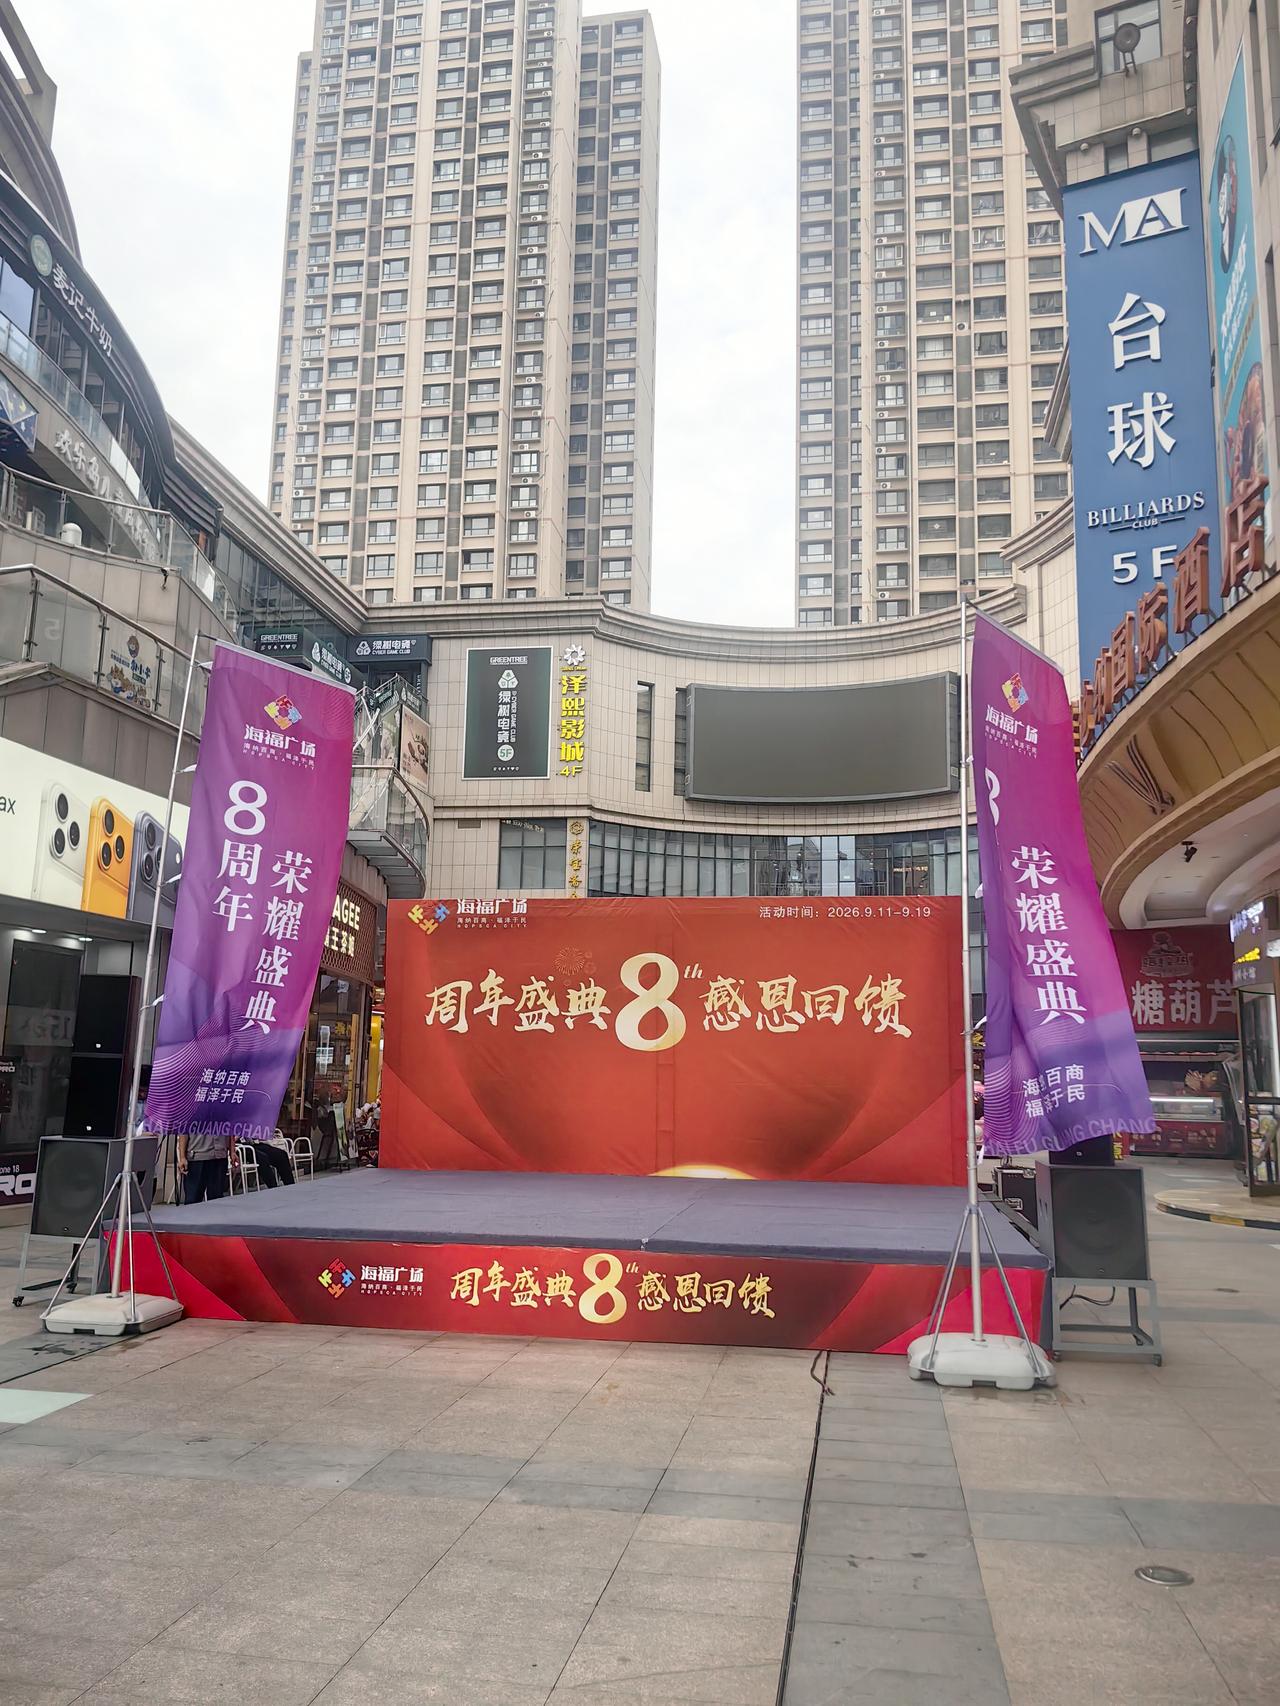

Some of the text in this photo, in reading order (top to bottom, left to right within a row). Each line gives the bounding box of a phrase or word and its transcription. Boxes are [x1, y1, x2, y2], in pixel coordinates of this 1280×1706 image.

[1107, 292, 1177, 468] 台球
[1087, 491, 1205, 528] BILLIARDS
[1132, 518, 1159, 530] CLUB
[1112, 544, 1178, 584] 5F
[260, 633, 298, 641] GREENTREE
[560, 674, 587, 762] 泽熙影城
[985, 704, 1038, 744] 海福广场
[244, 724, 316, 758] 海福广场
[499, 748, 512, 758] 5F
[560, 765, 583, 777] 4F
[213, 780, 268, 932] 8周年
[456, 898, 528, 915] 海福广场
[239, 850, 313, 1034] 荣耀盛典
[1011, 846, 1087, 1025] 荣耀盛典
[424, 968, 612, 1034] 周年盛典
[699, 973, 912, 1039] 感恩回馈
[1132, 979, 1237, 1026] 糖葫芦
[200, 1067, 252, 1086] 海纳百商
[194, 1086, 245, 1104] 福泽于民
[188, 1120, 231, 1136] GUANG
[12, 1164, 20, 1173] 18
[360, 1265, 424, 1283] 海福广场
[450, 1260, 577, 1309] 周年盛典
[636, 1270, 776, 1319] 感恩回馈
